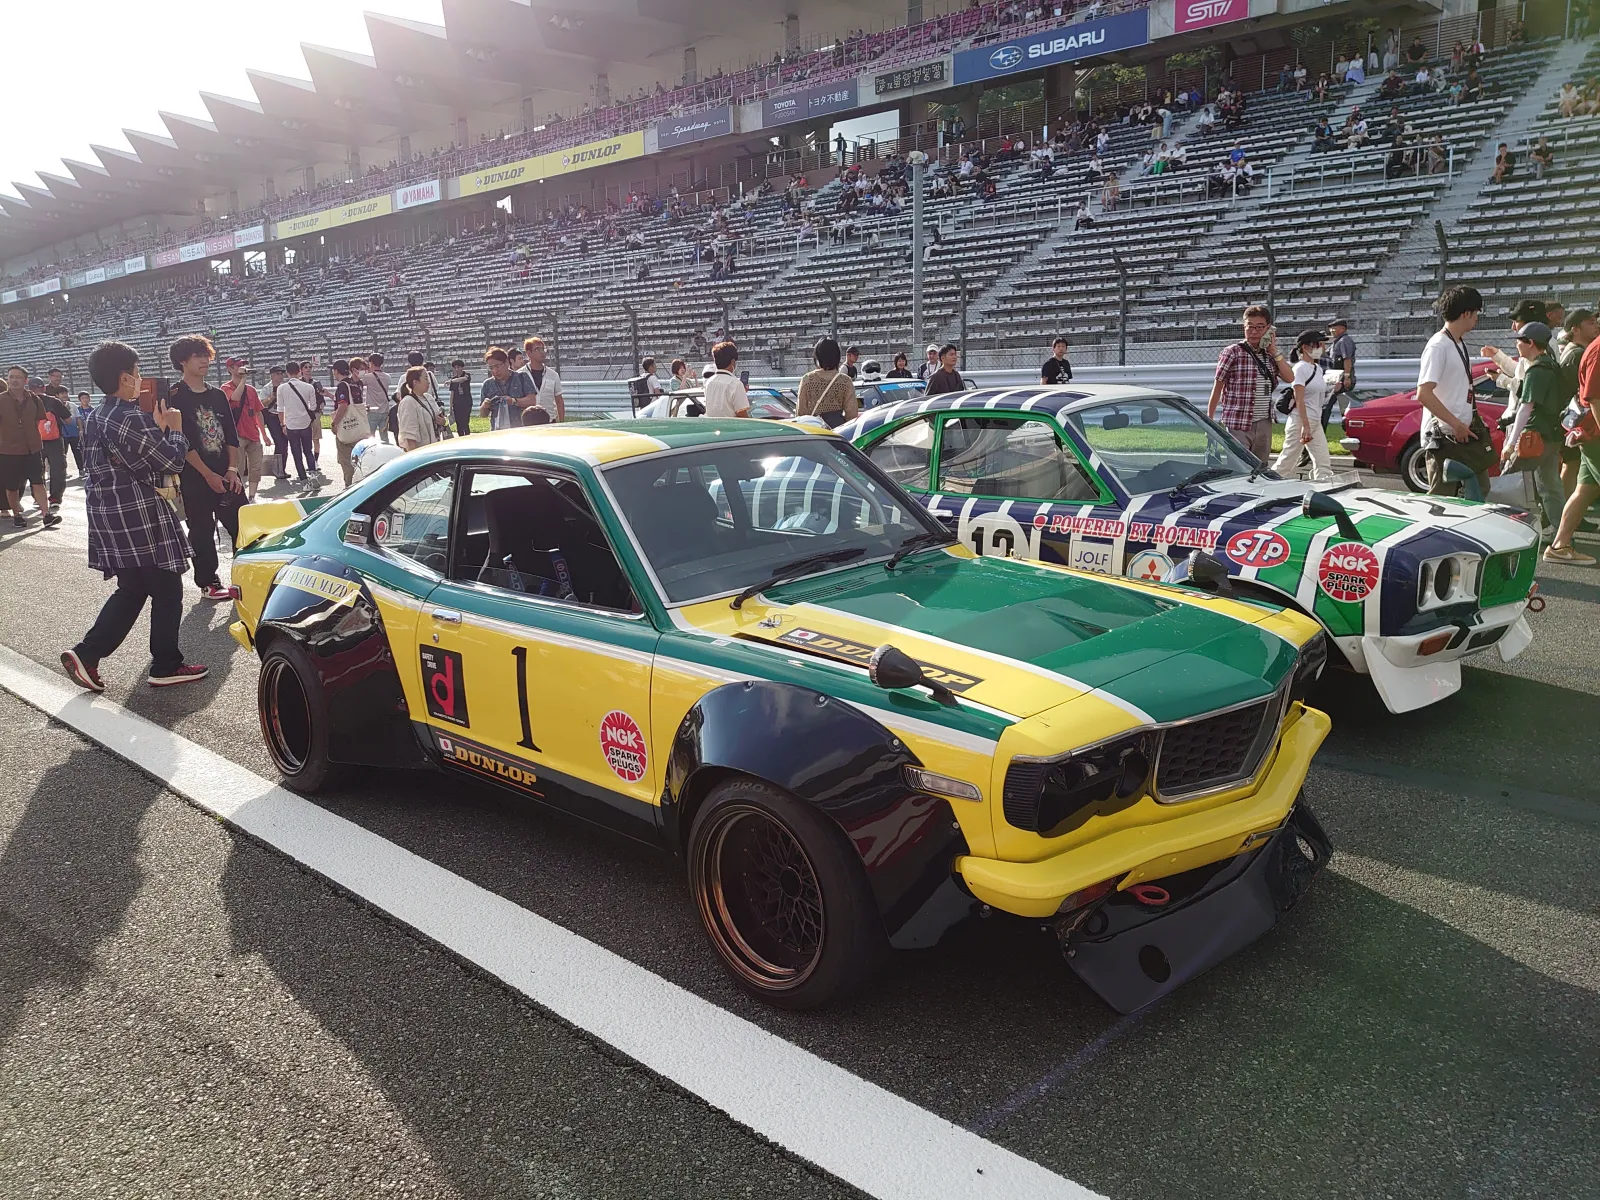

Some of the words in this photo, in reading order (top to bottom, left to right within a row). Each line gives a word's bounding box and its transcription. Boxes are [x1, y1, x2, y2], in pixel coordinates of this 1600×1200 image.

[1028, 29, 1106, 59] SUBARU
[774, 100, 796, 110] TOYOTA
[808, 91, 849, 108] トヨタ不動産
[671, 122, 711, 138] Speedway
[571, 143, 622, 164] DUNLOP
[483, 167, 525, 185] DUNLOP
[408, 185, 435, 202] YAMAHA
[348, 203, 378, 217] DUNLOP
[293, 218, 319, 231] DUNLOP
[180, 247, 205, 258] NISSAN
[206, 239, 232, 252] NISSAN
[156, 252, 180, 265] NISSAN
[1050, 514, 1125, 538] POWERED
[1129, 525, 1152, 542] BY
[1153, 526, 1220, 549] ROTARY
[1230, 533, 1284, 561] STP
[1075, 550, 1109, 565] JOLF
[1328, 554, 1371, 573] NGK
[1328, 572, 1366, 585] SPARK
[1326, 582, 1365, 594] PLUGS
[782, 636, 805, 644] JAPAN
[808, 638, 975, 685] DUOP
[511, 646, 542, 753] 1
[606, 726, 638, 749] NGK
[609, 747, 640, 763] SPARK
[455, 746, 537, 785] DUNLOP
[612, 757, 640, 773] PLUGS
